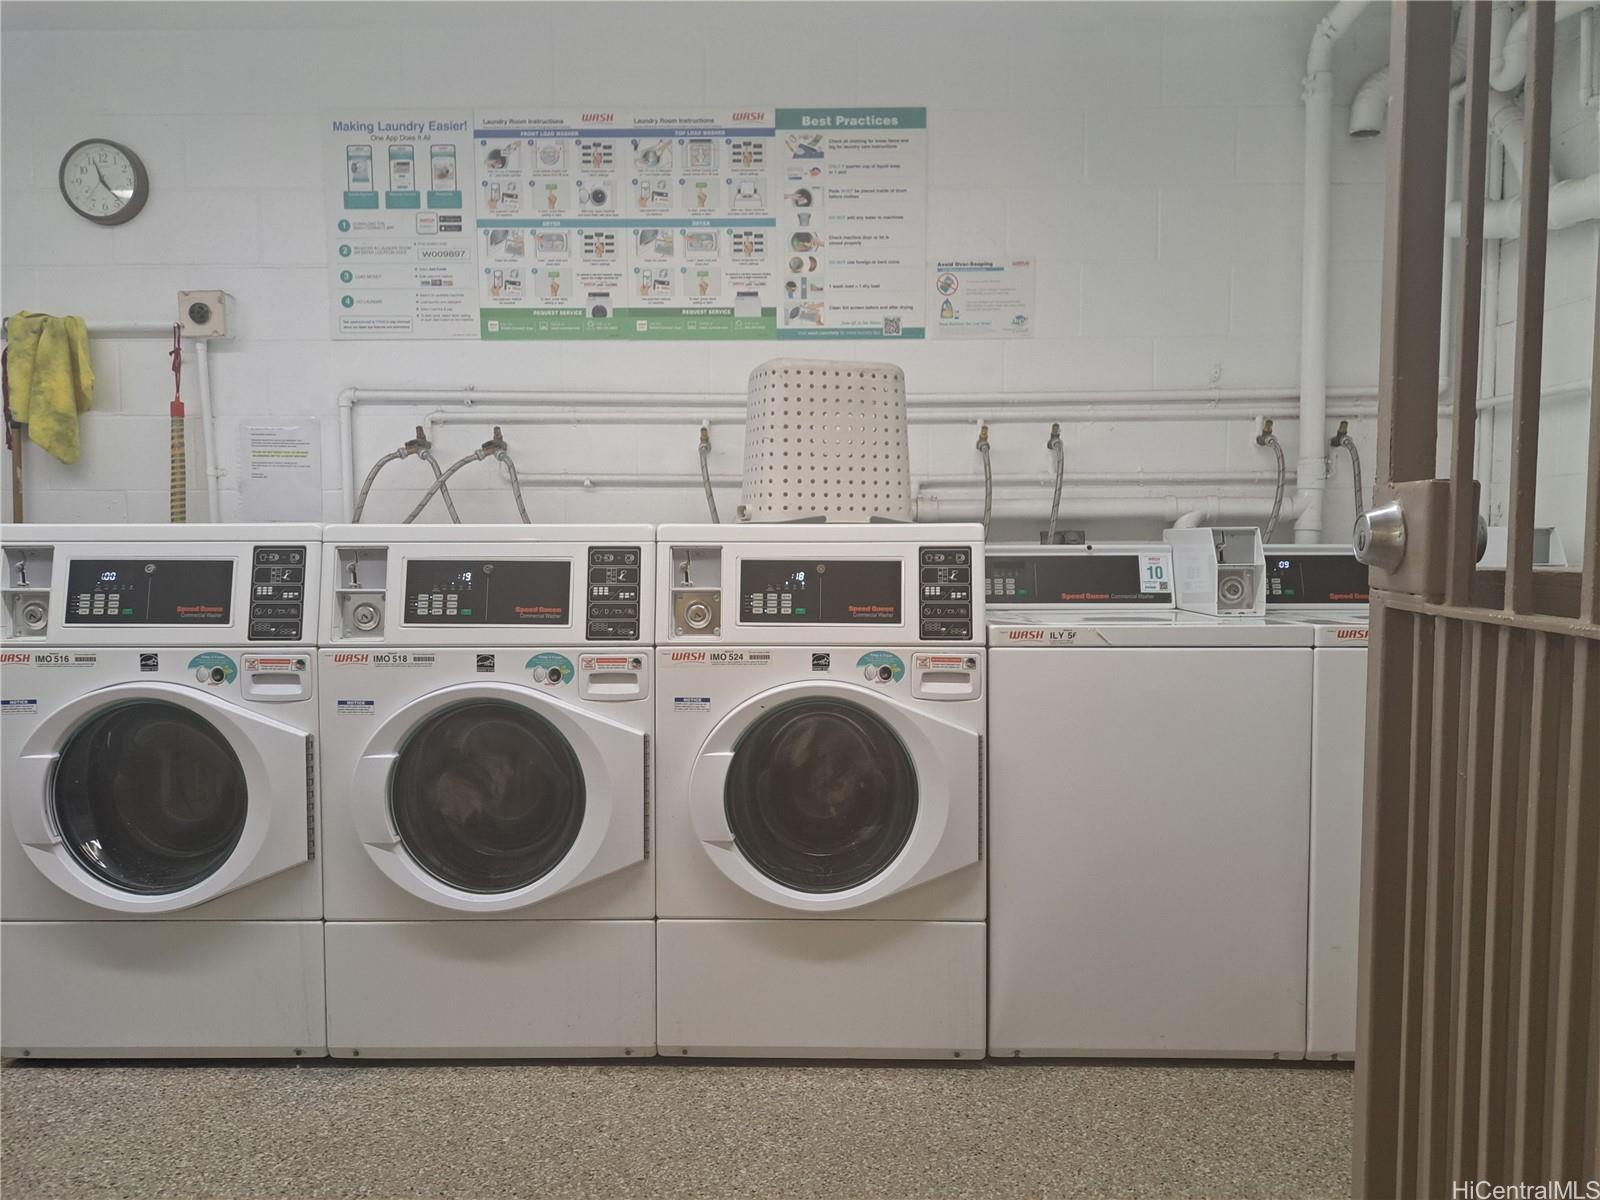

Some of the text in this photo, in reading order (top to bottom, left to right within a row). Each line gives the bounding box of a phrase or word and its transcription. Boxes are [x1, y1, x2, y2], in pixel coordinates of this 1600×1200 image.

[581, 112, 614, 122] WASH
[732, 112, 765, 121] WASH
[802, 115, 899, 126] Best Practices
[332, 120, 468, 134] Making Laundry Easier!
[1278, 560, 1290, 569] 09
[1146, 565, 1164, 580] 10
[1009, 630, 1044, 639] WASH
[334, 654, 368, 662] WASH
[672, 652, 706, 661] WASH
